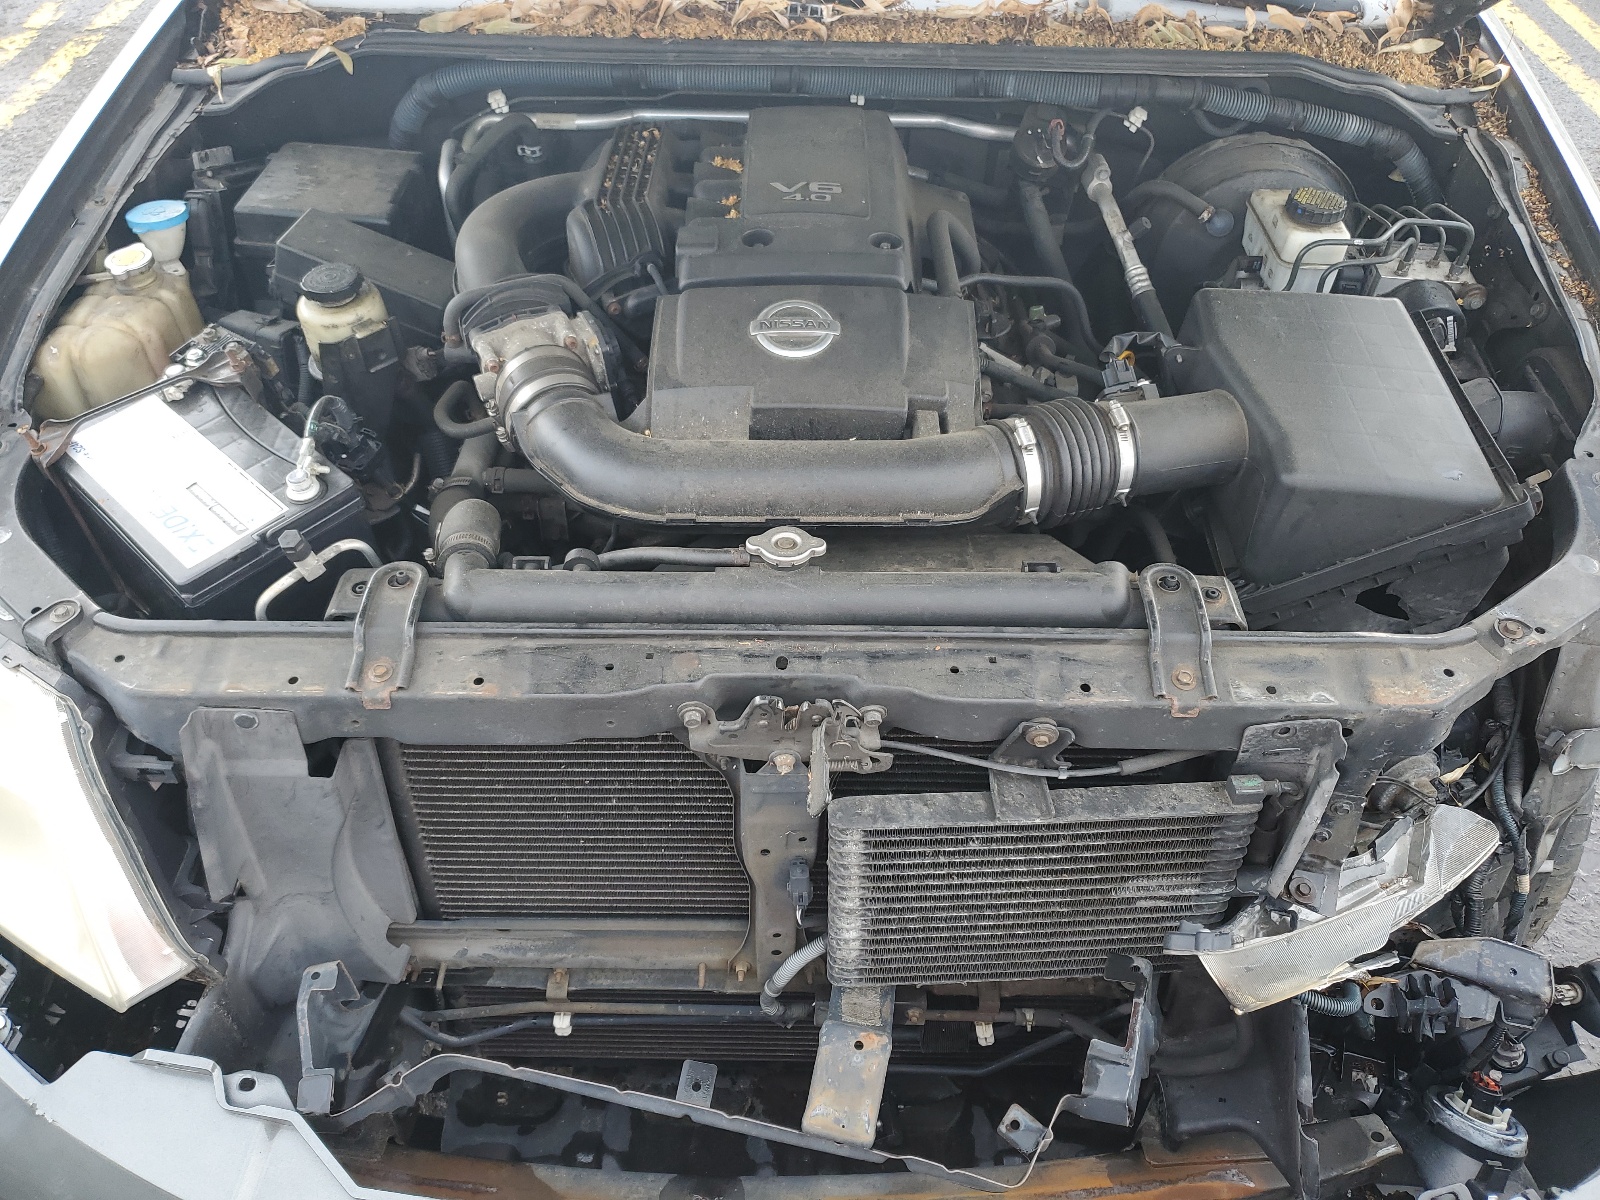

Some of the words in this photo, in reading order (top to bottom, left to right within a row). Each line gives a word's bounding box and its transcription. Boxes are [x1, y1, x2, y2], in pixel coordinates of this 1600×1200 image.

[769, 181, 843, 194] V6
[781, 193, 832, 201] 4.0
[759, 319, 831, 330] NISSAN
